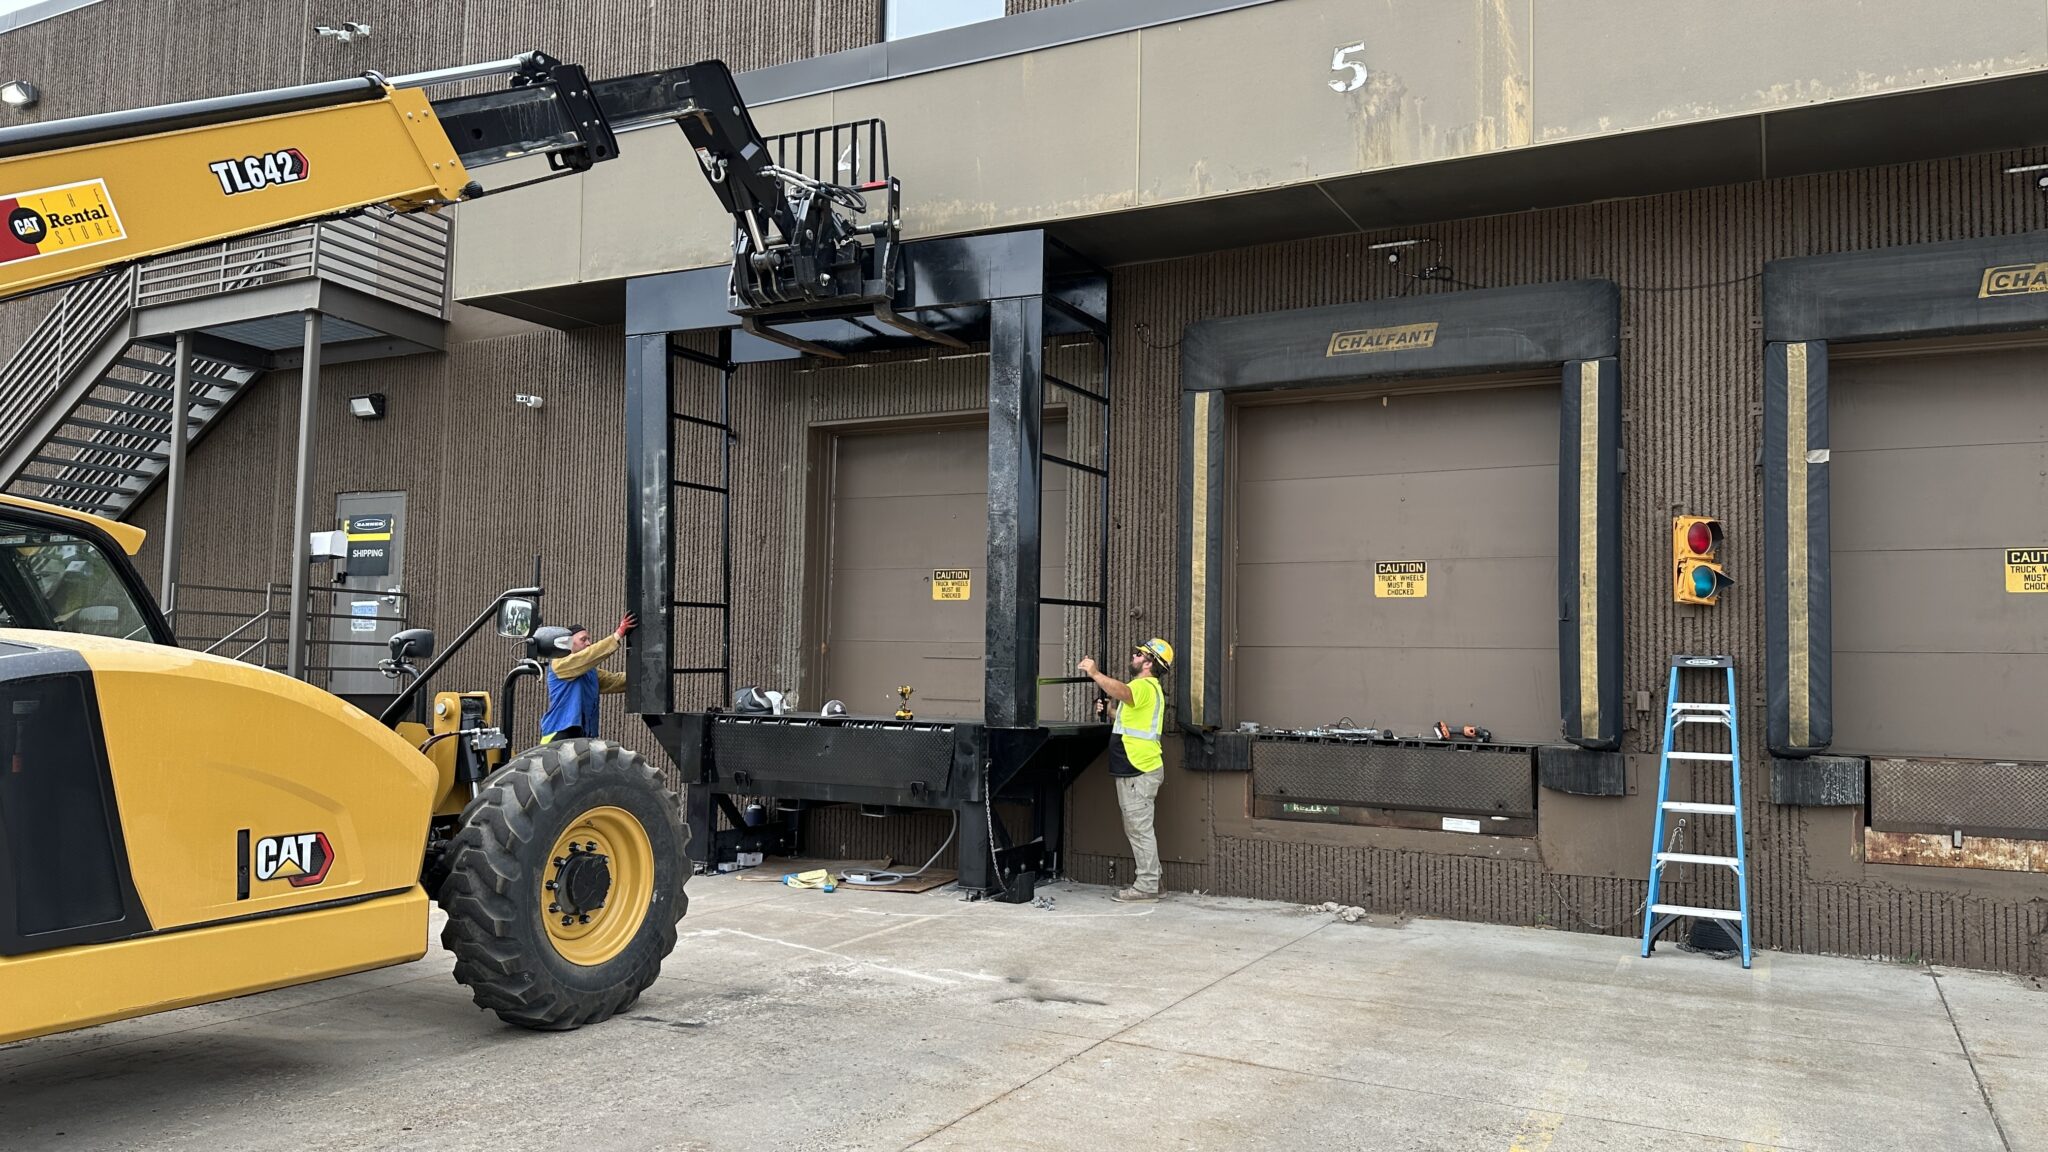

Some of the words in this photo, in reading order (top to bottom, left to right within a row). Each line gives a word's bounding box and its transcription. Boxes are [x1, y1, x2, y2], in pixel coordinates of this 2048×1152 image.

[1328, 41, 1368, 92] 5
[210, 151, 299, 194] TL642
[39, 188, 101, 213] THE
[13, 216, 40, 236] CAT
[46, 204, 109, 229] Rental
[55, 220, 115, 245] STORE
[1338, 330, 1434, 350] CHALFANT
[352, 549, 383, 557] SHIPPING
[2011, 551, 2048, 563] CAUT
[935, 571, 969, 580] CAUTION
[1378, 563, 1424, 573] CAUTION
[2010, 565, 2037, 574] TRUCK
[2023, 573, 2047, 582] MUST
[257, 833, 317, 880] CAT
